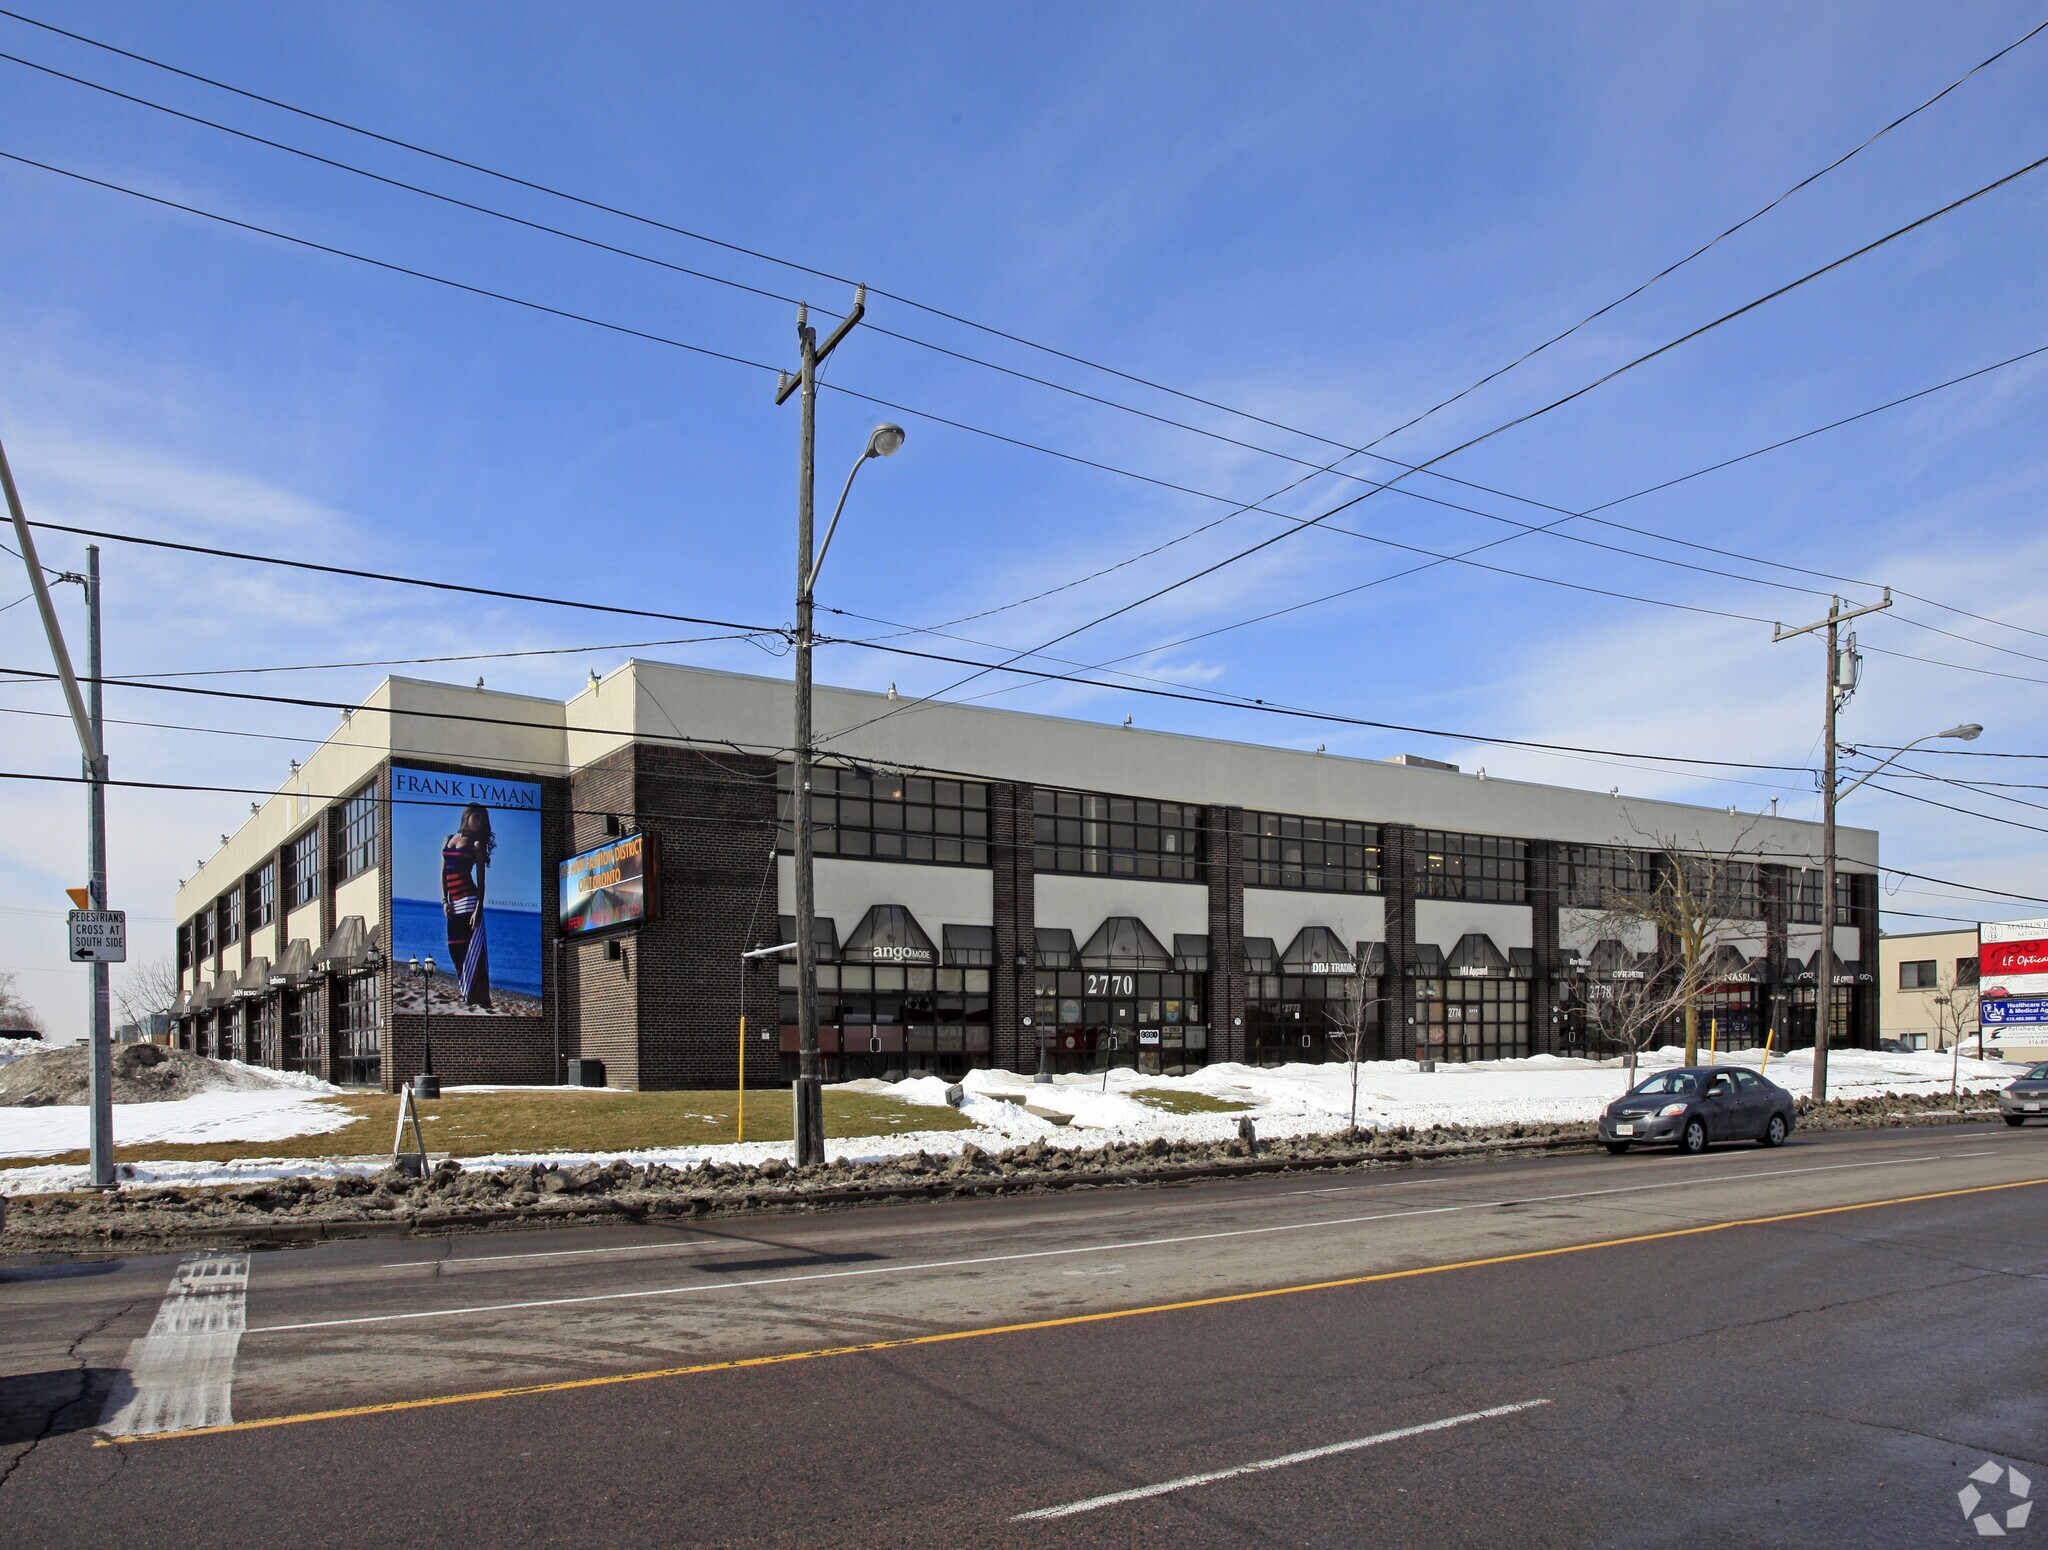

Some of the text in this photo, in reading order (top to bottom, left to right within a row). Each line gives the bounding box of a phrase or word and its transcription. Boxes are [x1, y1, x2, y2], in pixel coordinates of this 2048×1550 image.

[396, 774, 535, 805] FRANK LYMAN
[615, 838, 643, 862] DISTRICT
[590, 868, 621, 889] TORONTO
[71, 912, 124, 923] PEDESTRIANS
[76, 925, 119, 935] CROSS AT
[76, 938, 123, 947] SOUTH SIDE
[912, 950, 930, 958] MODE
[2003, 956, 2014, 966] LF
[1312, 963, 1329, 973] DDJ
[1087, 975, 1133, 995] 2770
[1590, 985, 1611, 998] 2778
[1285, 1004, 1300, 1012] 2772
[1448, 1008, 1461, 1017] 2774
